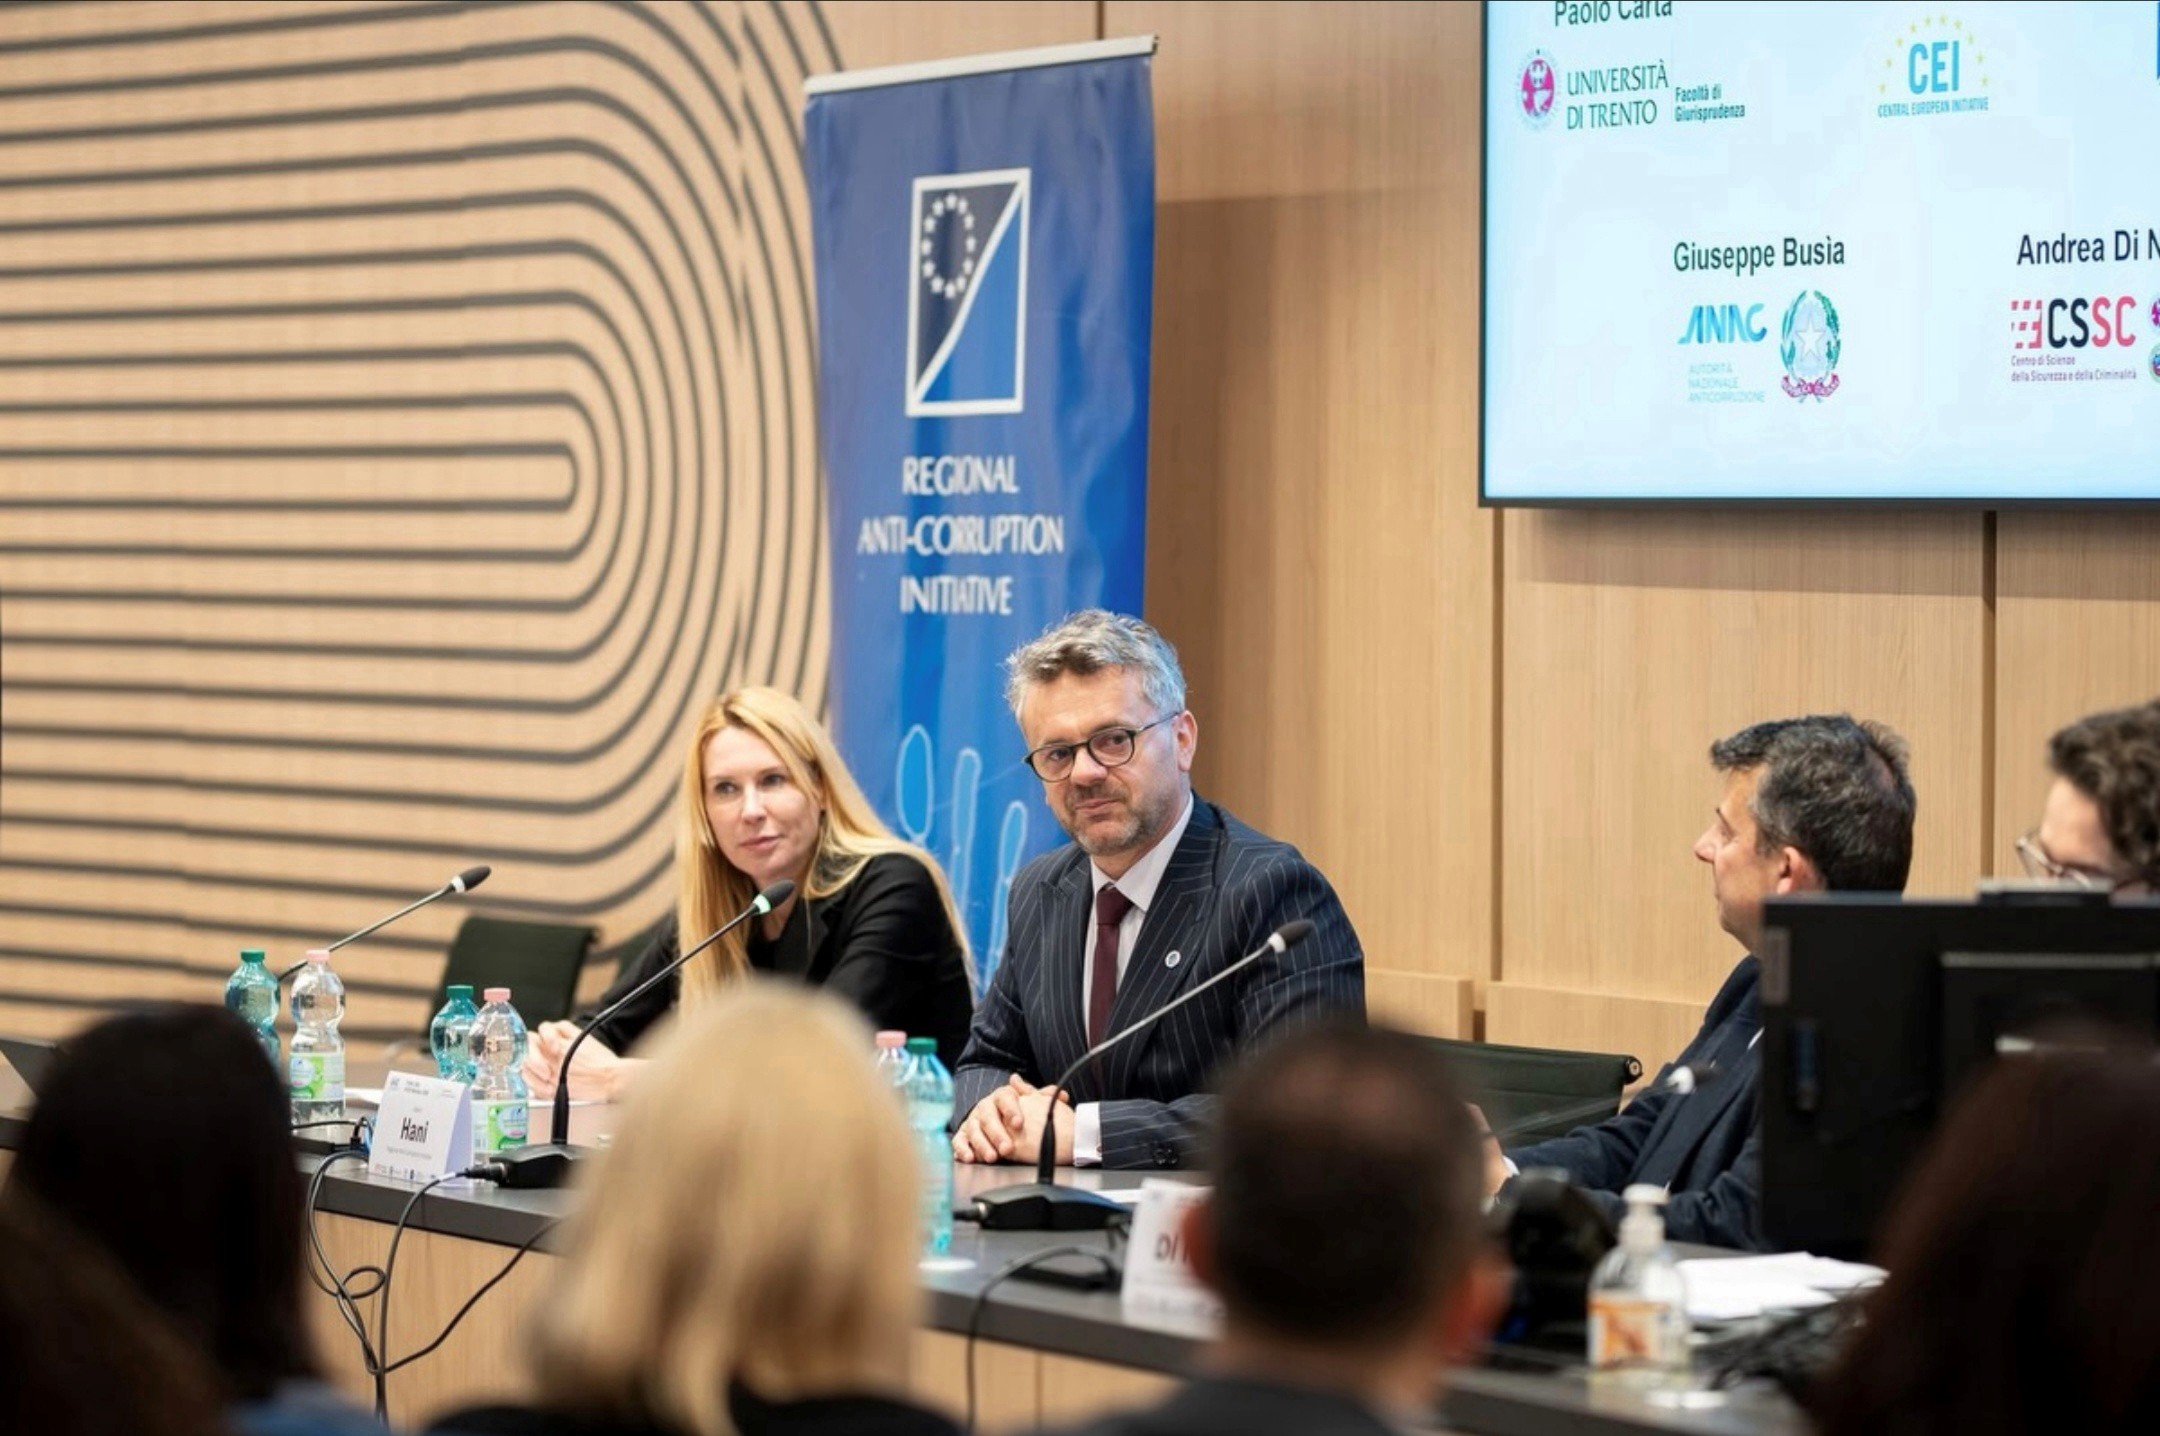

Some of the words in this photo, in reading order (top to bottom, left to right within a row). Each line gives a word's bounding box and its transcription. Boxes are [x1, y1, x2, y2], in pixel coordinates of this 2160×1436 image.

[1555, 1, 1611, 27] Paolo
[1567, 59, 1669, 96] UNIVERSITÀ
[1908, 40, 1960, 95] CEI
[1712, 83, 1722, 100] di
[1567, 105, 1583, 130] DI
[1587, 99, 1658, 128] TRENTO
[1674, 104, 1745, 123] Giurisprudenza
[1673, 241, 1776, 277] Giuseppe
[1783, 235, 1845, 267] Busìa
[2017, 232, 2105, 266] Andrea
[2115, 229, 2139, 261] Di
[2047, 295, 2137, 349] CSSC
[902, 455, 1020, 496] REGIONAL
[857, 514, 1064, 556] ANTI-CORRUPTION
[900, 574, 1014, 616] INITIATIVE
[400, 1116, 429, 1144] Hani
